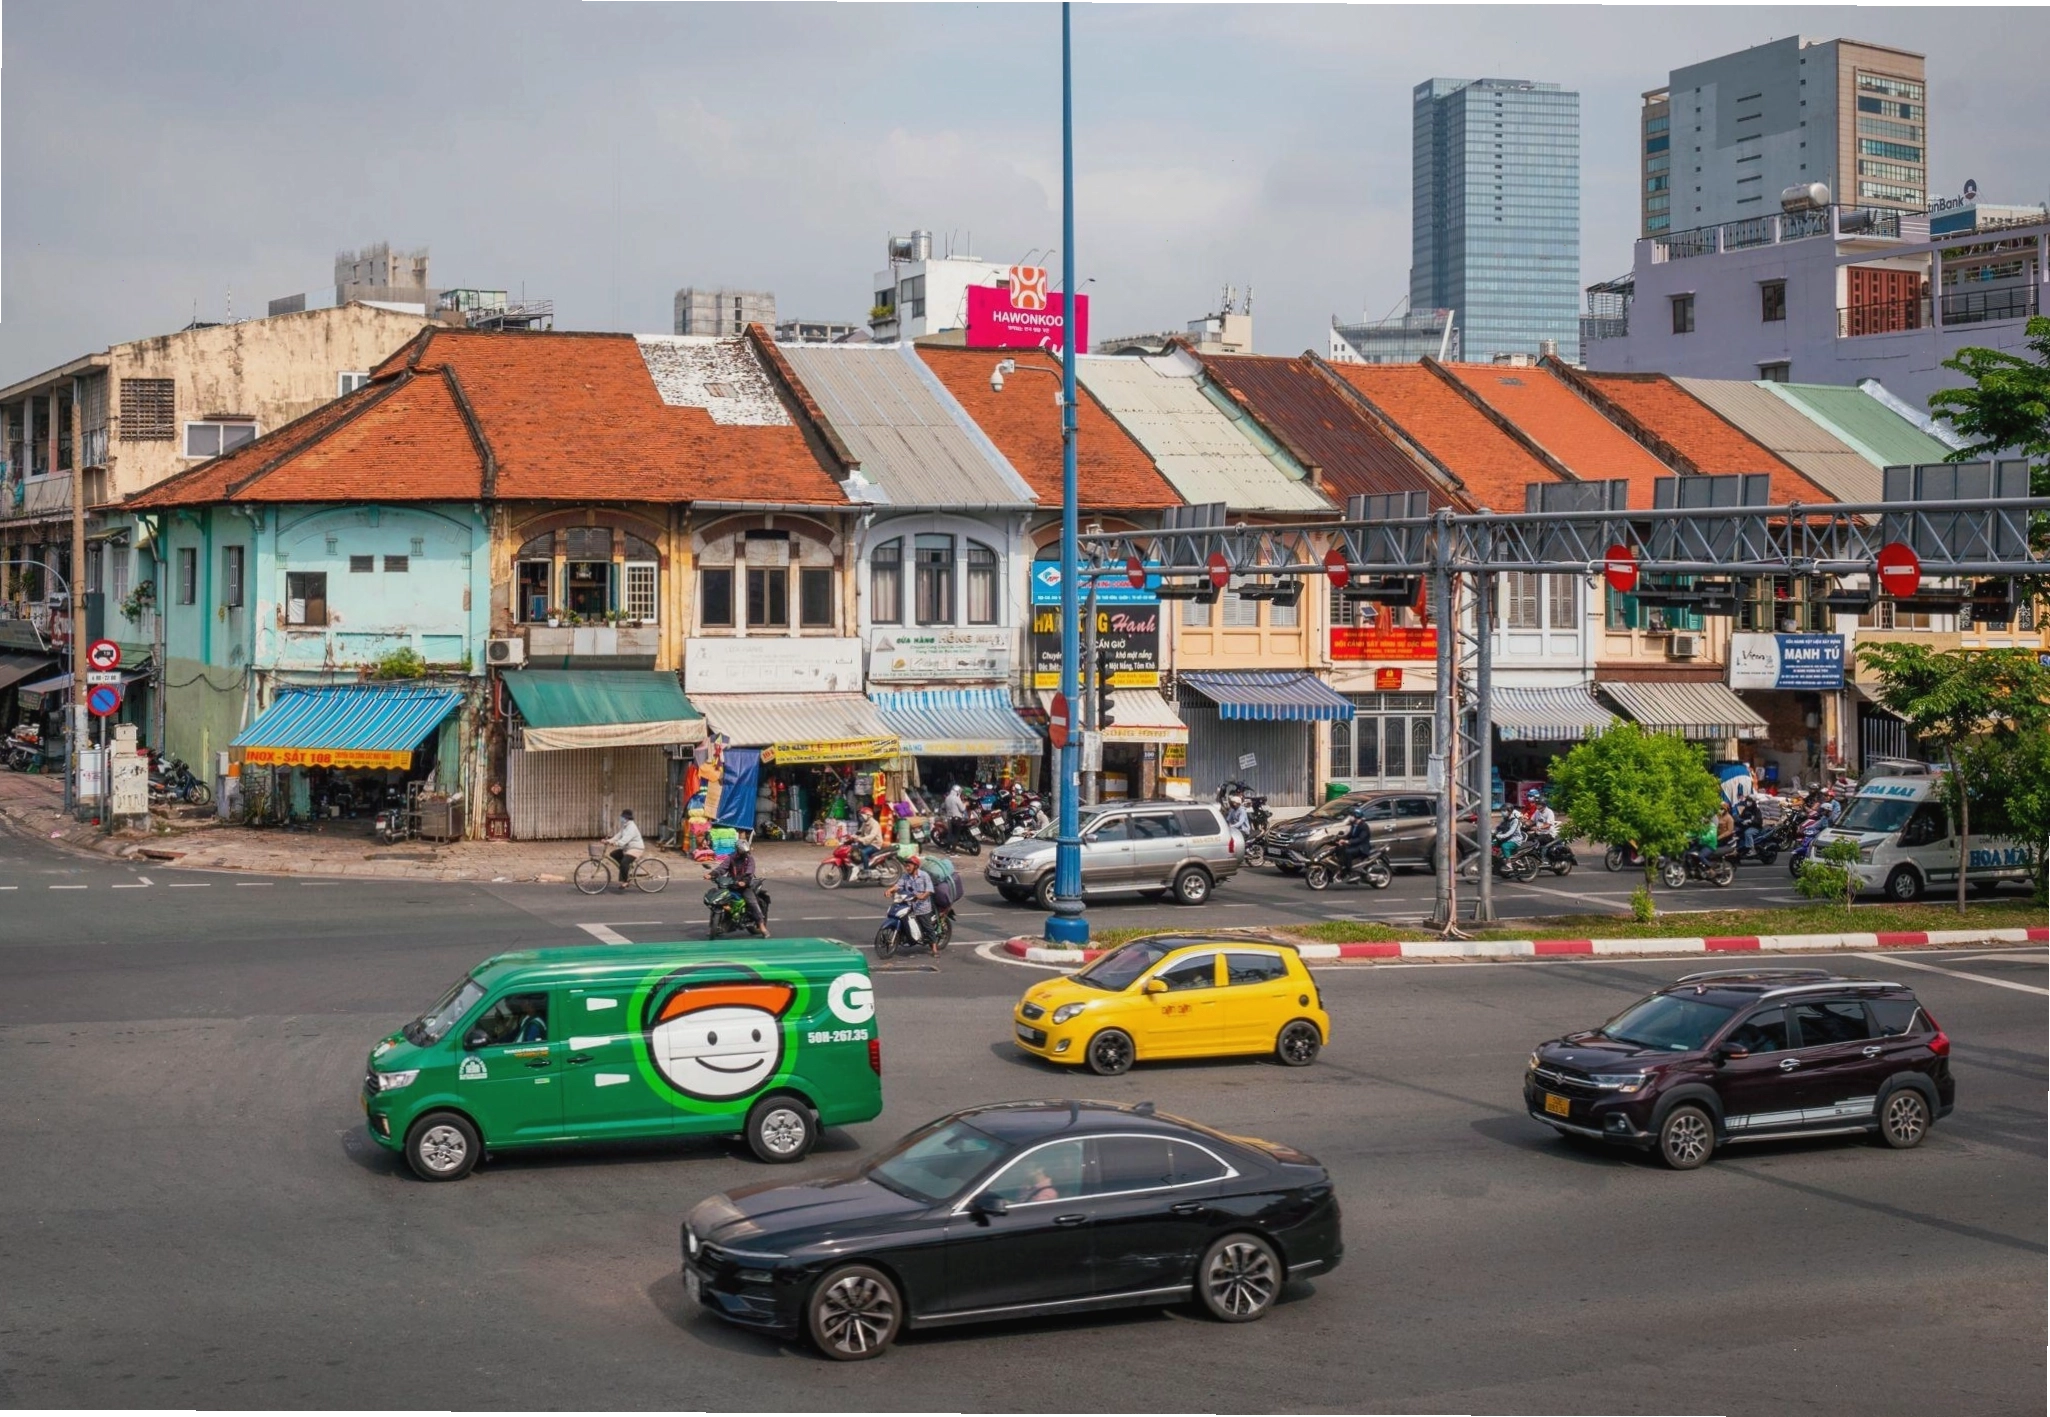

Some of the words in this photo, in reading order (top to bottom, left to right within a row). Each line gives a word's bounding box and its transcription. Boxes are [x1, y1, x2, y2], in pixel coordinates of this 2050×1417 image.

[993, 311, 1063, 327] HAWONKOO
[1111, 612, 1156, 638] Hạnh
[1784, 648, 1820, 663] MẠNH
[1824, 645, 1840, 660] TÚ
[246, 751, 274, 762] INOX
[283, 749, 306, 763] SẮT
[311, 753, 331, 764] 108
[1862, 785, 1884, 794] HOA
[1887, 786, 1916, 797] MAI
[1970, 849, 2001, 867] HOA
[827, 972, 875, 1024] G
[807, 1029, 869, 1044] 50H-267.35
